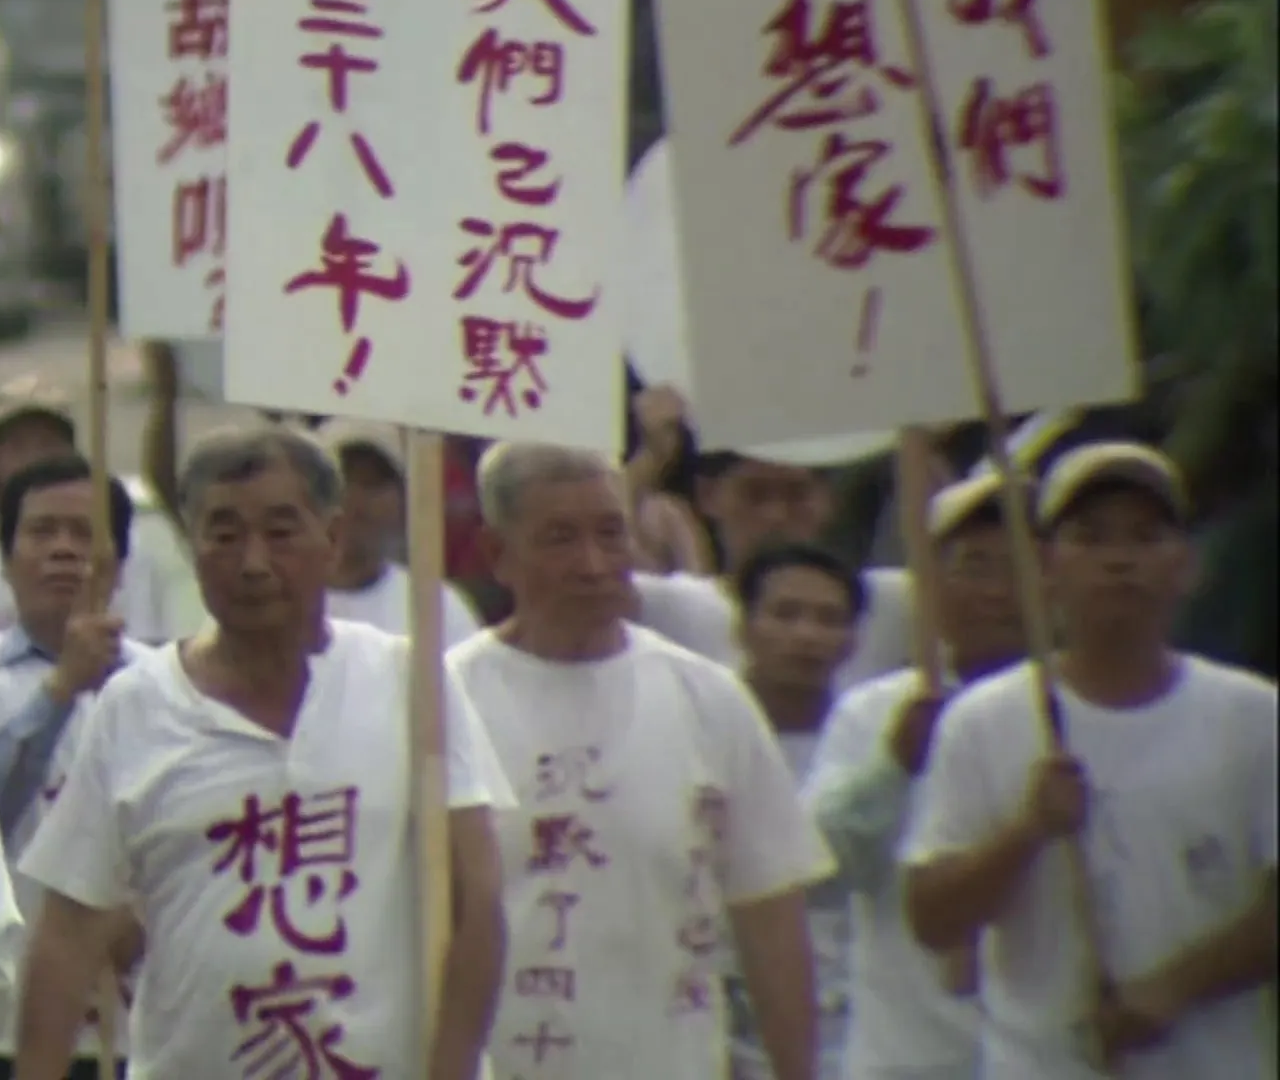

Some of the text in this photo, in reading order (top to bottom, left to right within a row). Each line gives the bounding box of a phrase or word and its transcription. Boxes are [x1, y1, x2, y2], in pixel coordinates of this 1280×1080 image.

[512, 746, 614, 1080] 沉默了四十
